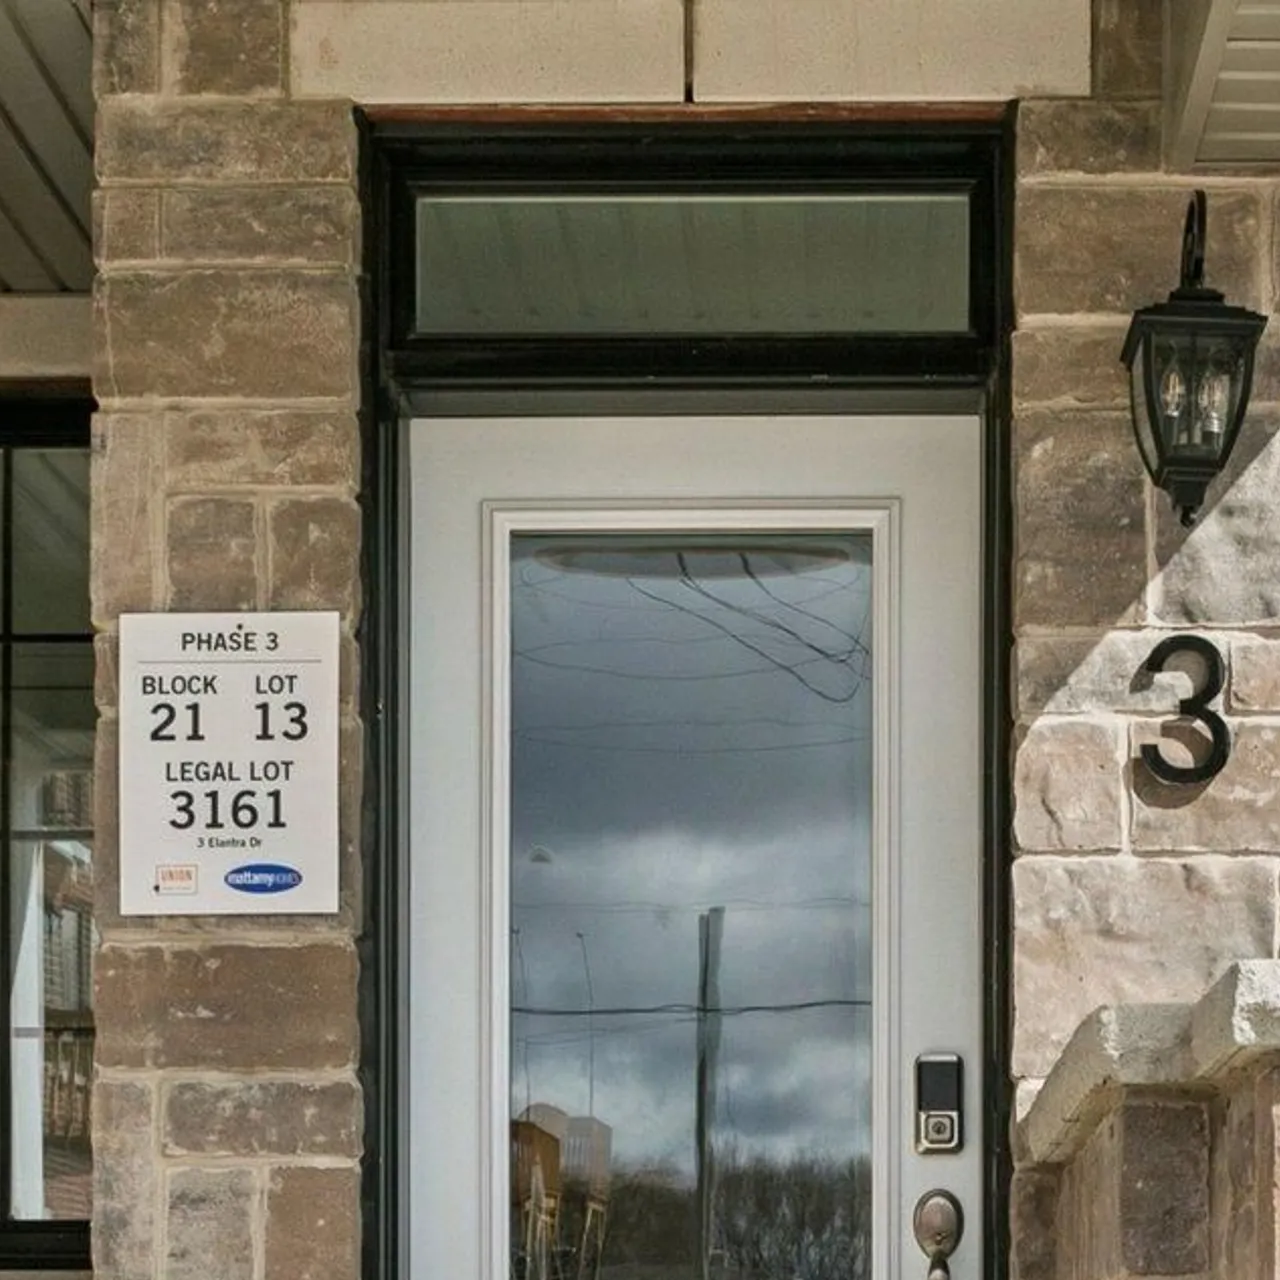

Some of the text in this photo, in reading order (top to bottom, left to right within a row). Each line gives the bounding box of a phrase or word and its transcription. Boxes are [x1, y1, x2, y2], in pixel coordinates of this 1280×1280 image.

[181, 632, 279, 651] PHASE 3
[141, 675, 298, 695] BLOCK LOT
[1129, 634, 1231, 784] 3
[150, 702, 308, 741] 21 13
[166, 761, 294, 782] LEGAL LOT
[170, 790, 287, 829] 3161
[197, 837, 205, 848] 3
[250, 837, 262, 848] Dr
